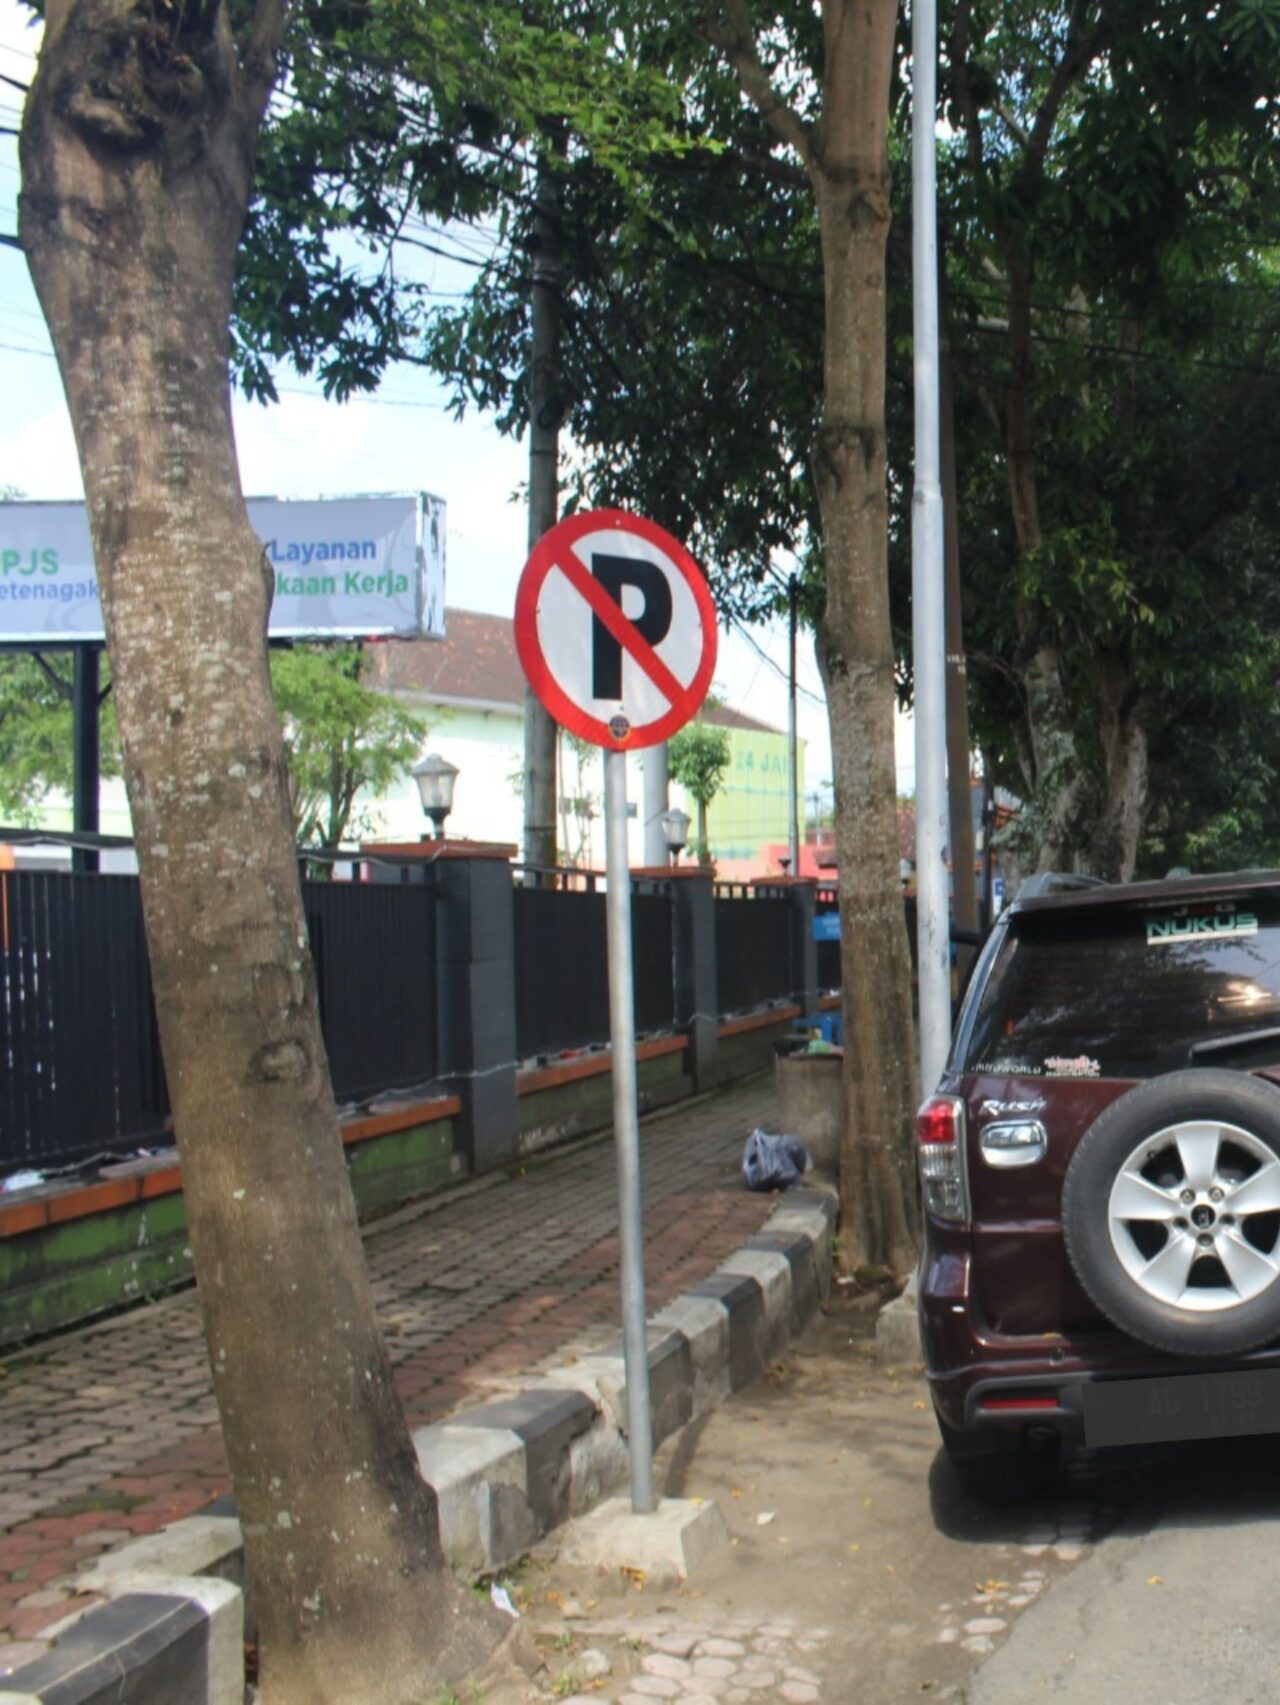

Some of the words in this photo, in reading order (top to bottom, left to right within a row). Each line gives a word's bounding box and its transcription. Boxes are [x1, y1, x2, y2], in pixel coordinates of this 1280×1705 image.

[272, 539, 376, 565] Layanan
[345, 569, 409, 598] Kerja
[592, 553, 673, 701] P
[1144, 912, 1259, 938] NUKUS
